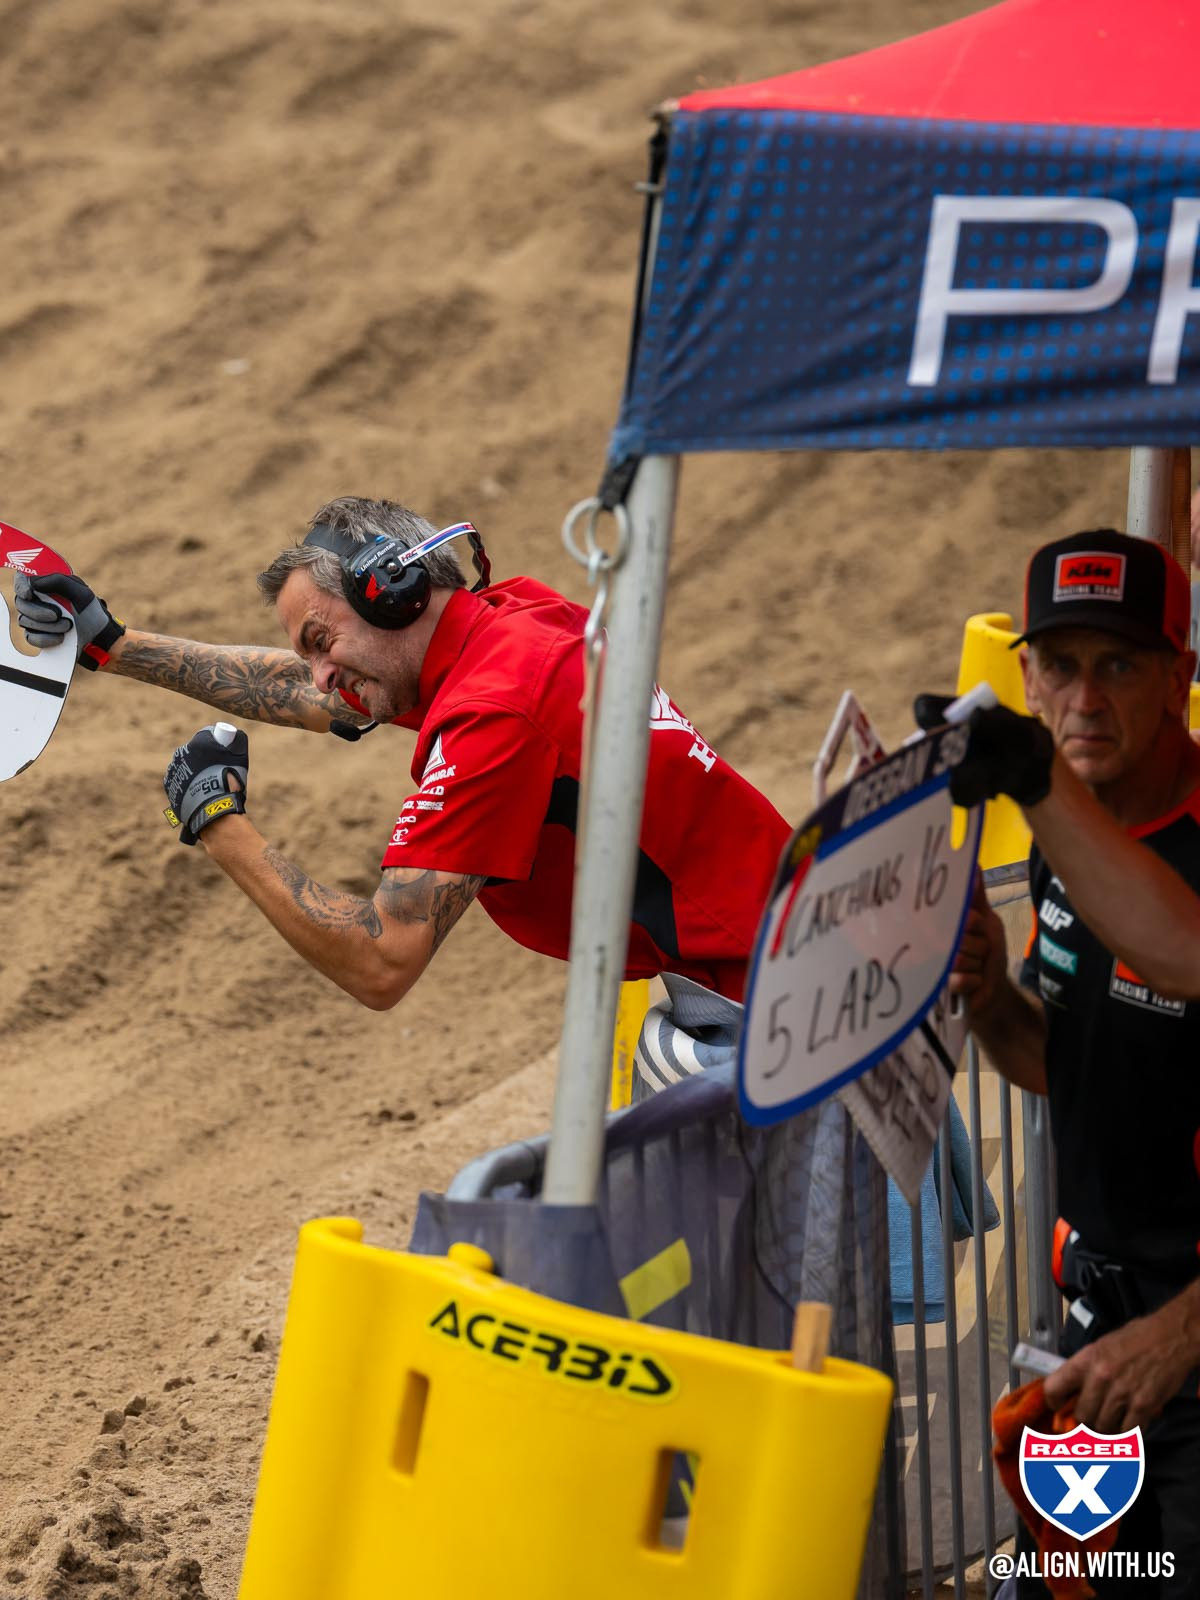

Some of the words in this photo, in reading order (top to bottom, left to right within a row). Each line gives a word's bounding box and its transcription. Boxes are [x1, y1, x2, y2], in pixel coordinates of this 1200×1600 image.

[3, 561, 39, 577] HONDA
[361, 554, 378, 571] United
[915, 824, 949, 912] 16
[1038, 898, 1075, 932] WP
[762, 993, 793, 1080] 5
[806, 943, 911, 1054] LAPS
